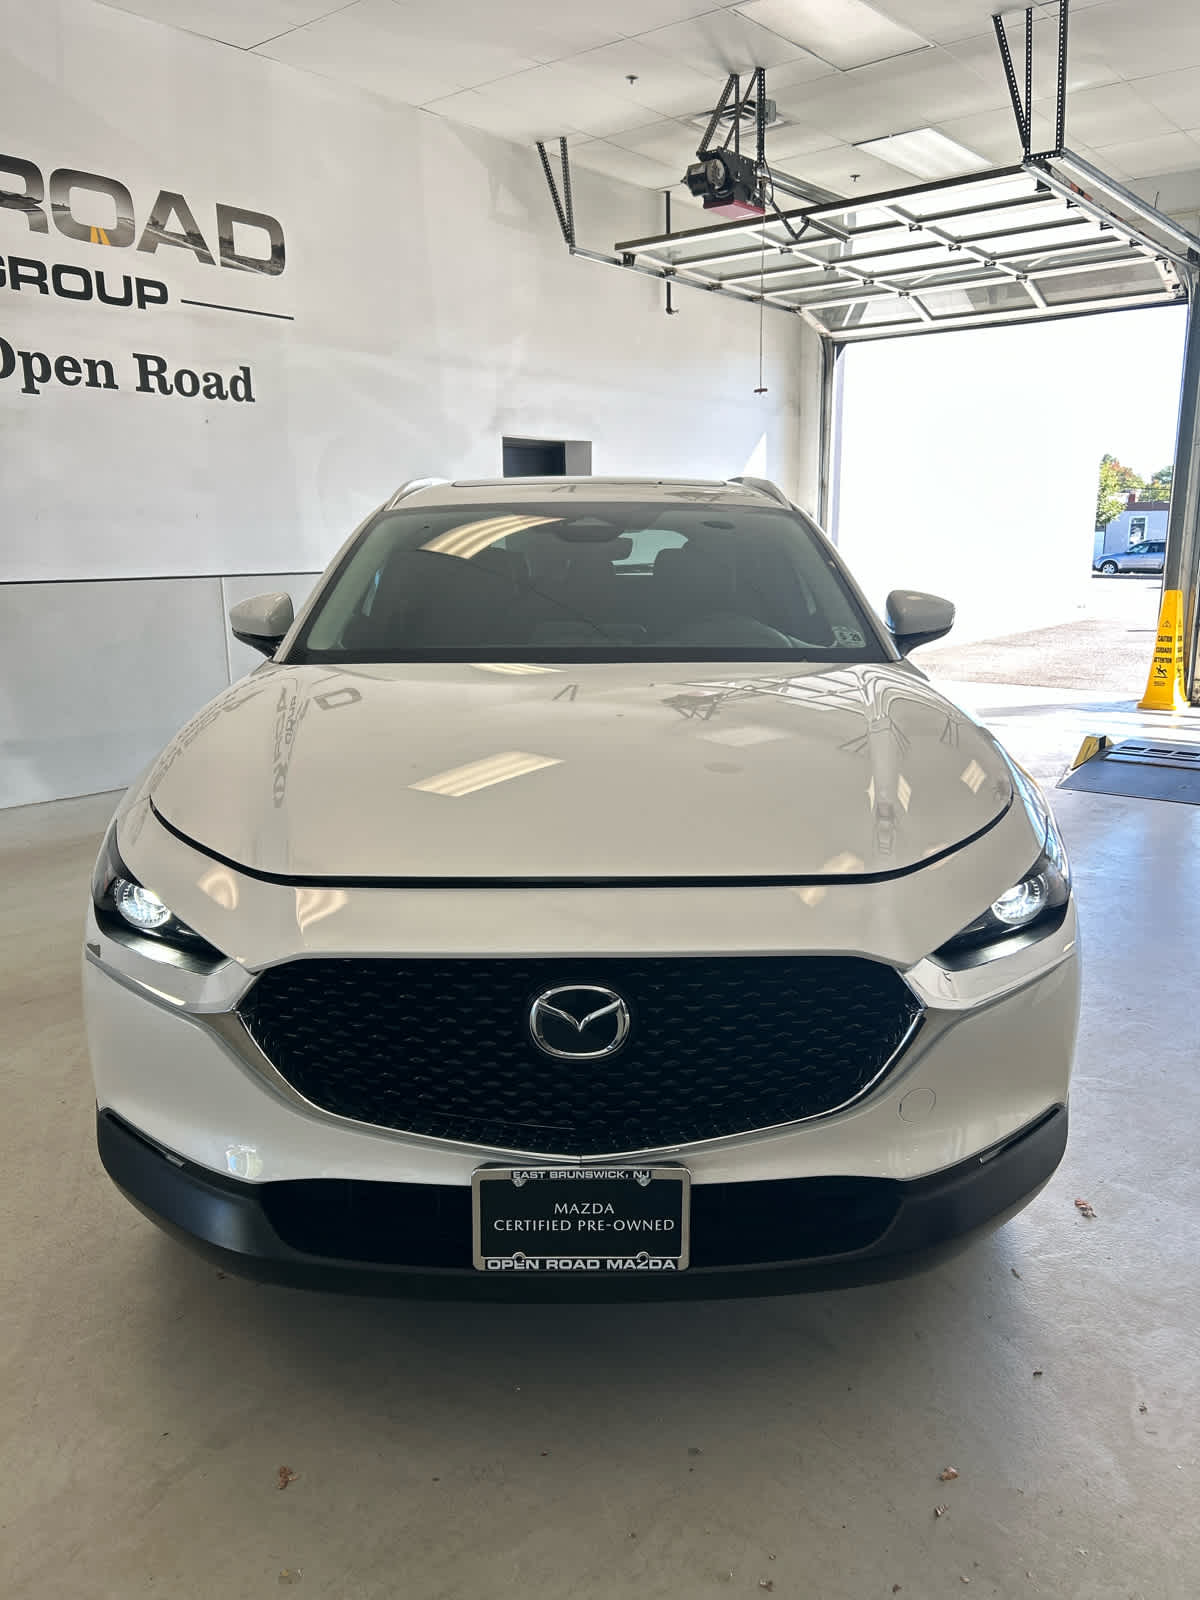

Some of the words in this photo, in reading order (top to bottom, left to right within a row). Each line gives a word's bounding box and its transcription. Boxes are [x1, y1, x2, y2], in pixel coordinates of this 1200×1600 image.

[0, 255, 168, 309] ROUP
[132, 352, 256, 402] Road
[512, 1171, 546, 1179] EAST
[550, 1171, 628, 1179] BRUNSWICK,
[633, 1170, 650, 1179] NJ
[554, 1203, 615, 1214] MAZDA
[494, 1219, 572, 1231] CERTIFIED
[578, 1219, 675, 1231] PRE-OWNED
[487, 1259, 540, 1270] OPEN
[546, 1259, 600, 1270] ROAD
[606, 1259, 677, 1270] MAZDA
